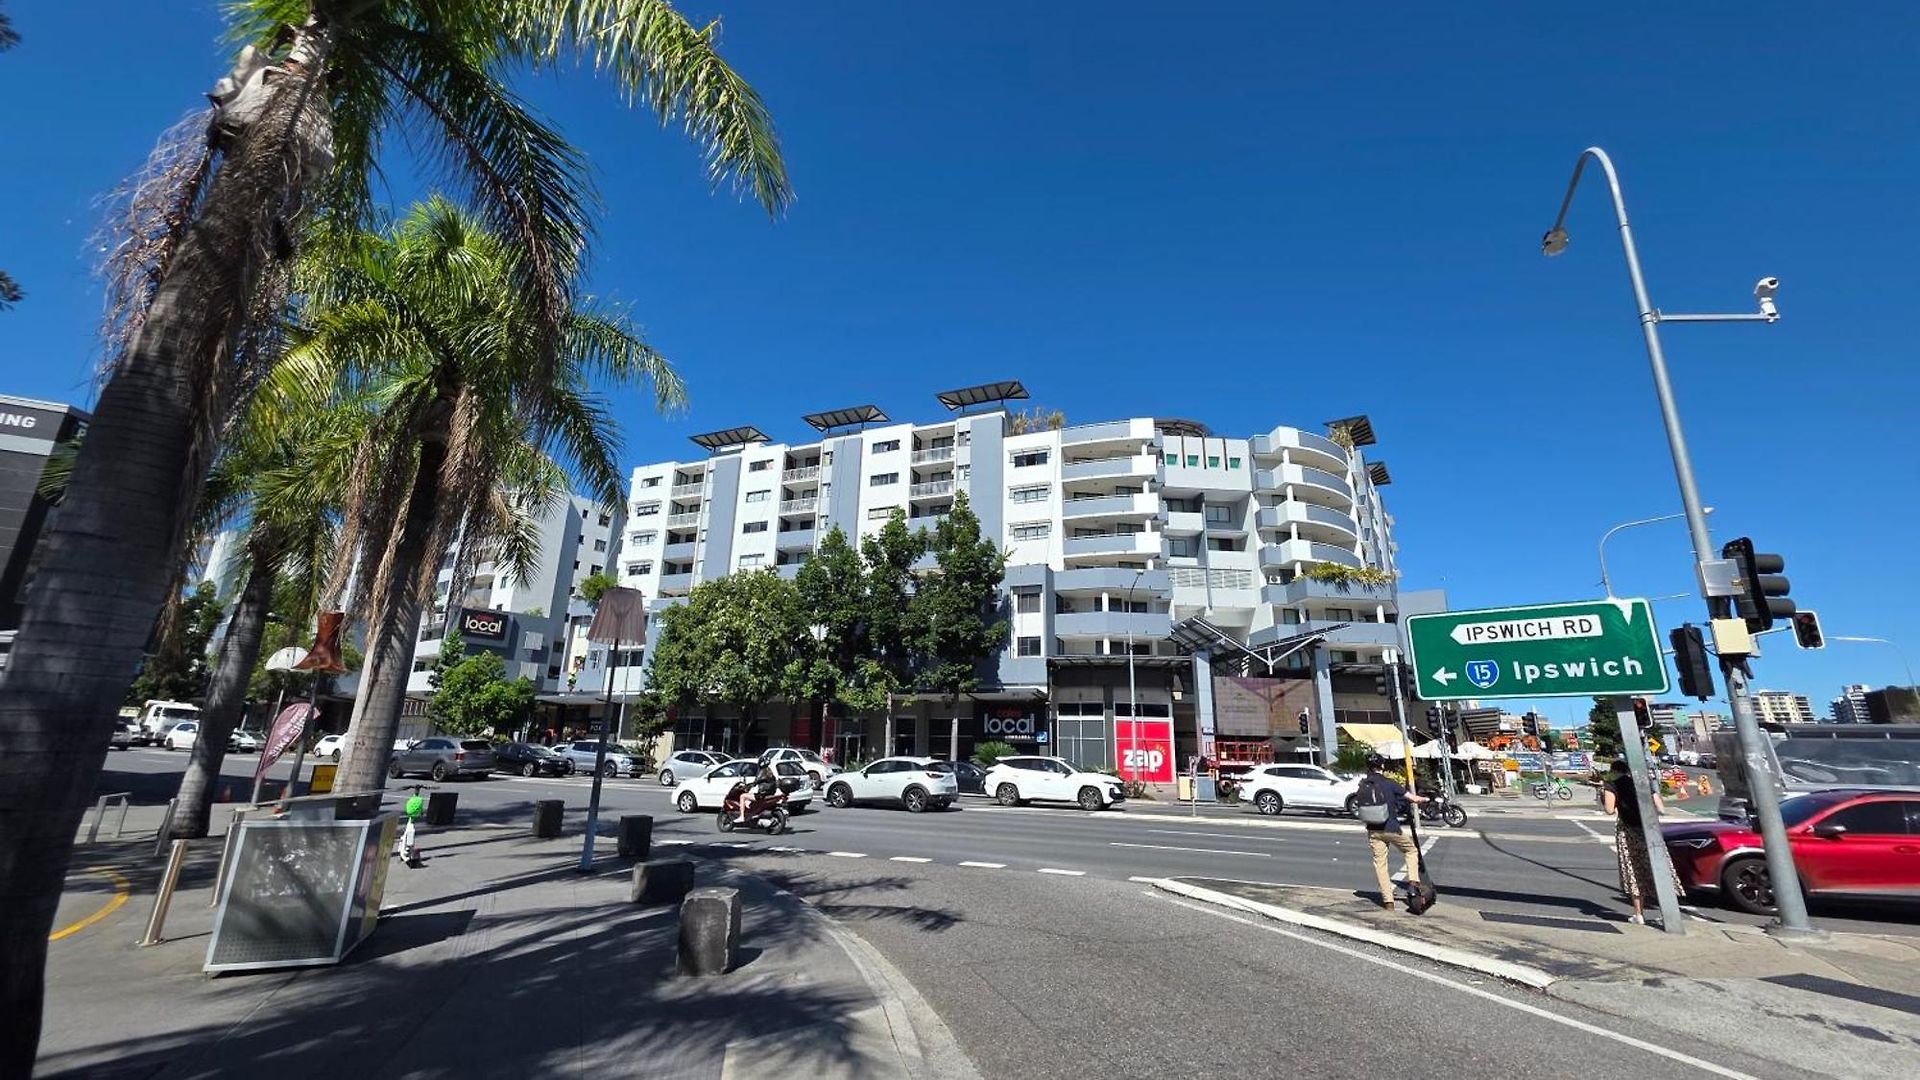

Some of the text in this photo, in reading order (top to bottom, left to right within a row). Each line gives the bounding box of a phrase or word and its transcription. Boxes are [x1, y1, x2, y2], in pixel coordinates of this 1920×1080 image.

[465, 615, 502, 633] local
[1466, 618, 1593, 641] IPSWICH RD
[1474, 664, 1491, 680] 15
[1513, 656, 1643, 684] Ipswich
[984, 713, 1035, 733] local
[1123, 749, 1163, 773] zap
